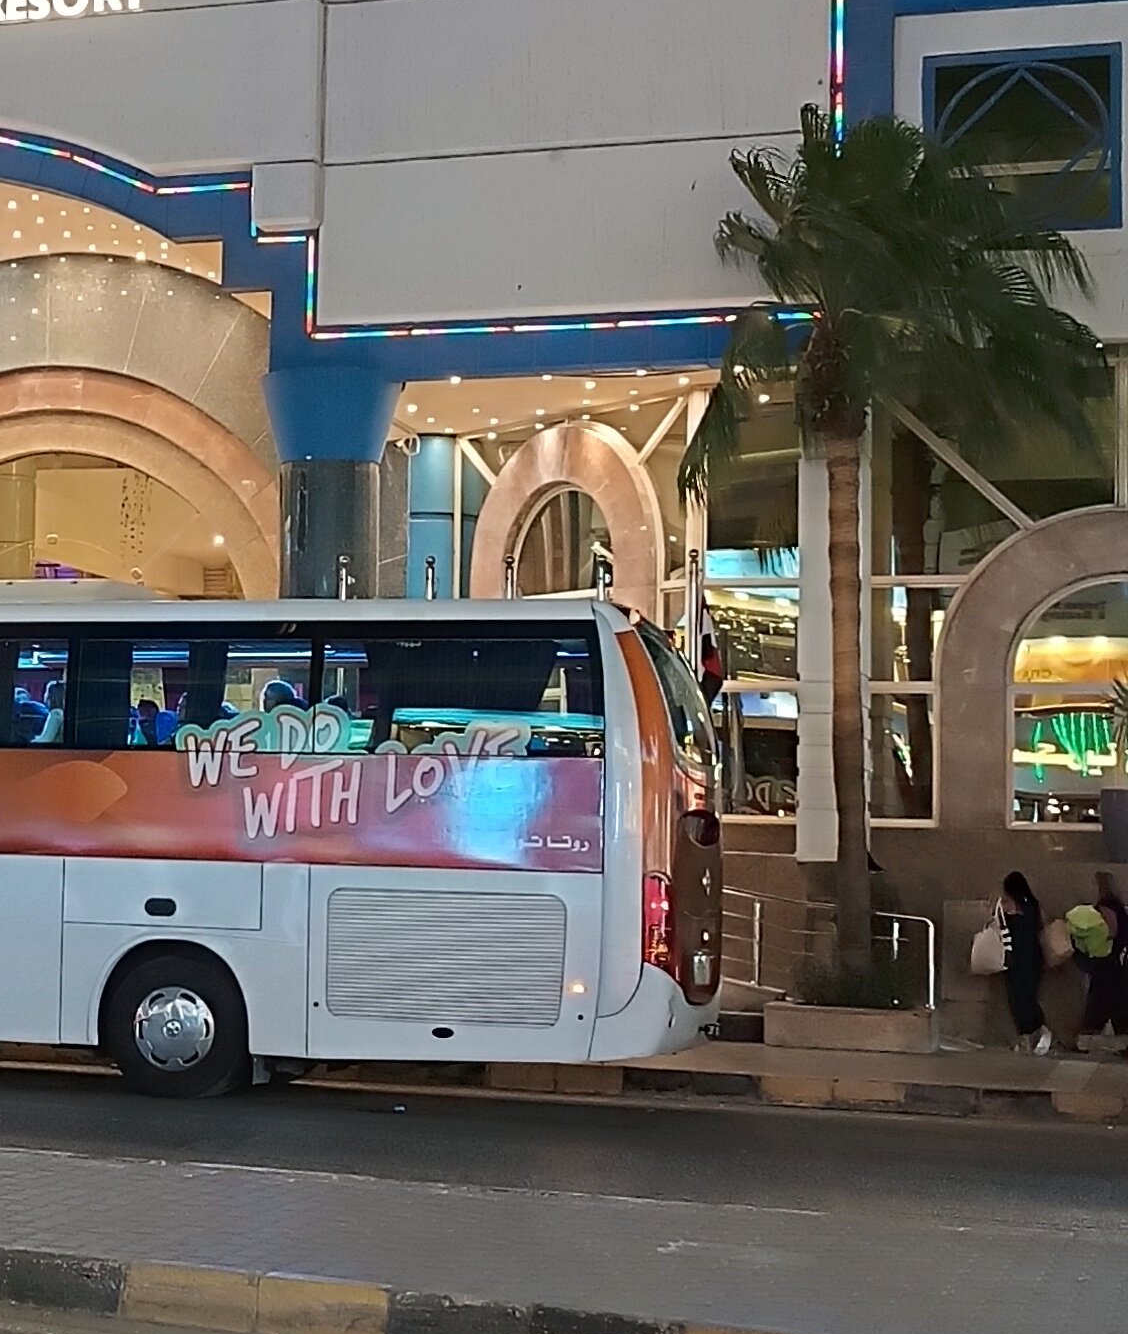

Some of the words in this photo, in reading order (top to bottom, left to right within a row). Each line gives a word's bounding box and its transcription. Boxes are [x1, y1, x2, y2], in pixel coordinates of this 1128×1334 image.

[186, 720, 260, 788] WE
[278, 713, 341, 769] DO
[243, 759, 362, 839] WITH
[385, 728, 520, 813] LOVE
